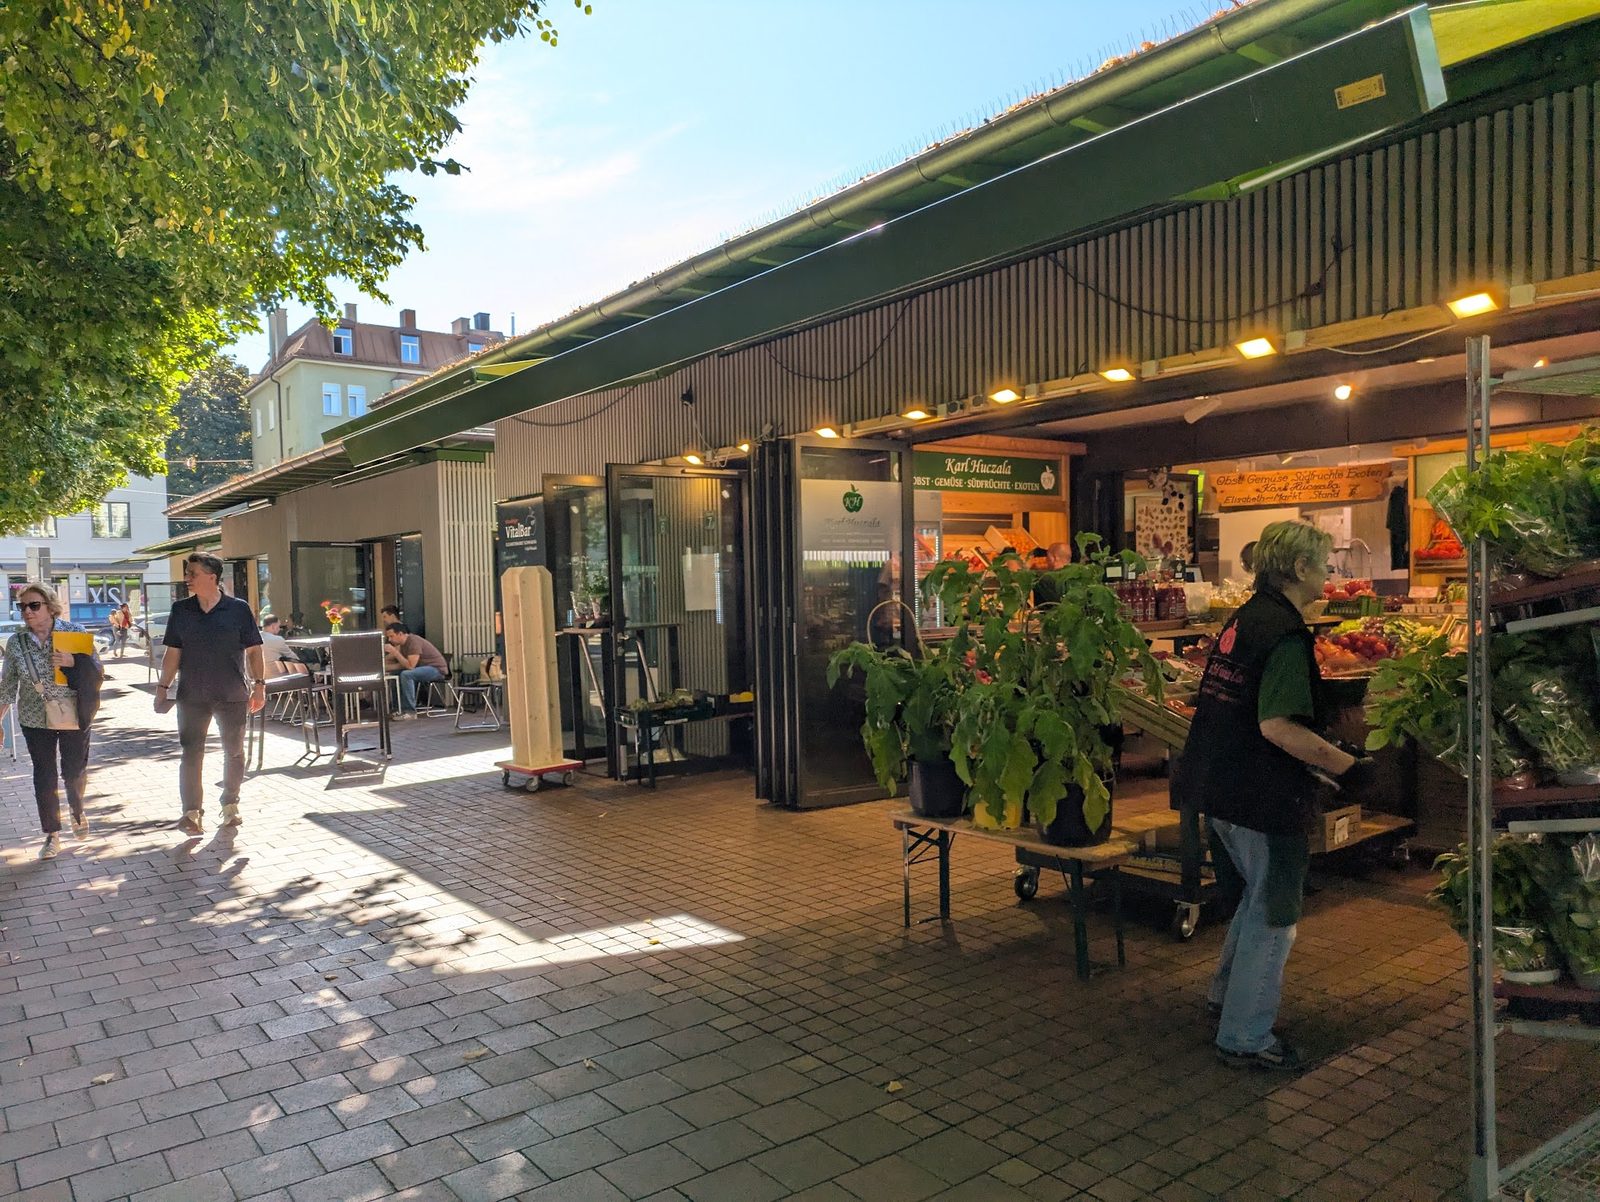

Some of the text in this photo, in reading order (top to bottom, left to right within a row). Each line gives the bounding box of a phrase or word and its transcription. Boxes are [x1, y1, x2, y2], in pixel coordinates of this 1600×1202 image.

[945, 457, 1012, 475] Karl Huczala
[1346, 466, 1383, 479] Exoten
[934, 476, 964, 488] GEMÜSE
[967, 477, 1011, 490] SÜDFRÜCHTE
[1014, 482, 1040, 491] EXOTEN
[1309, 489, 1340, 500] Stand
[505, 522, 532, 539] VitalBar
